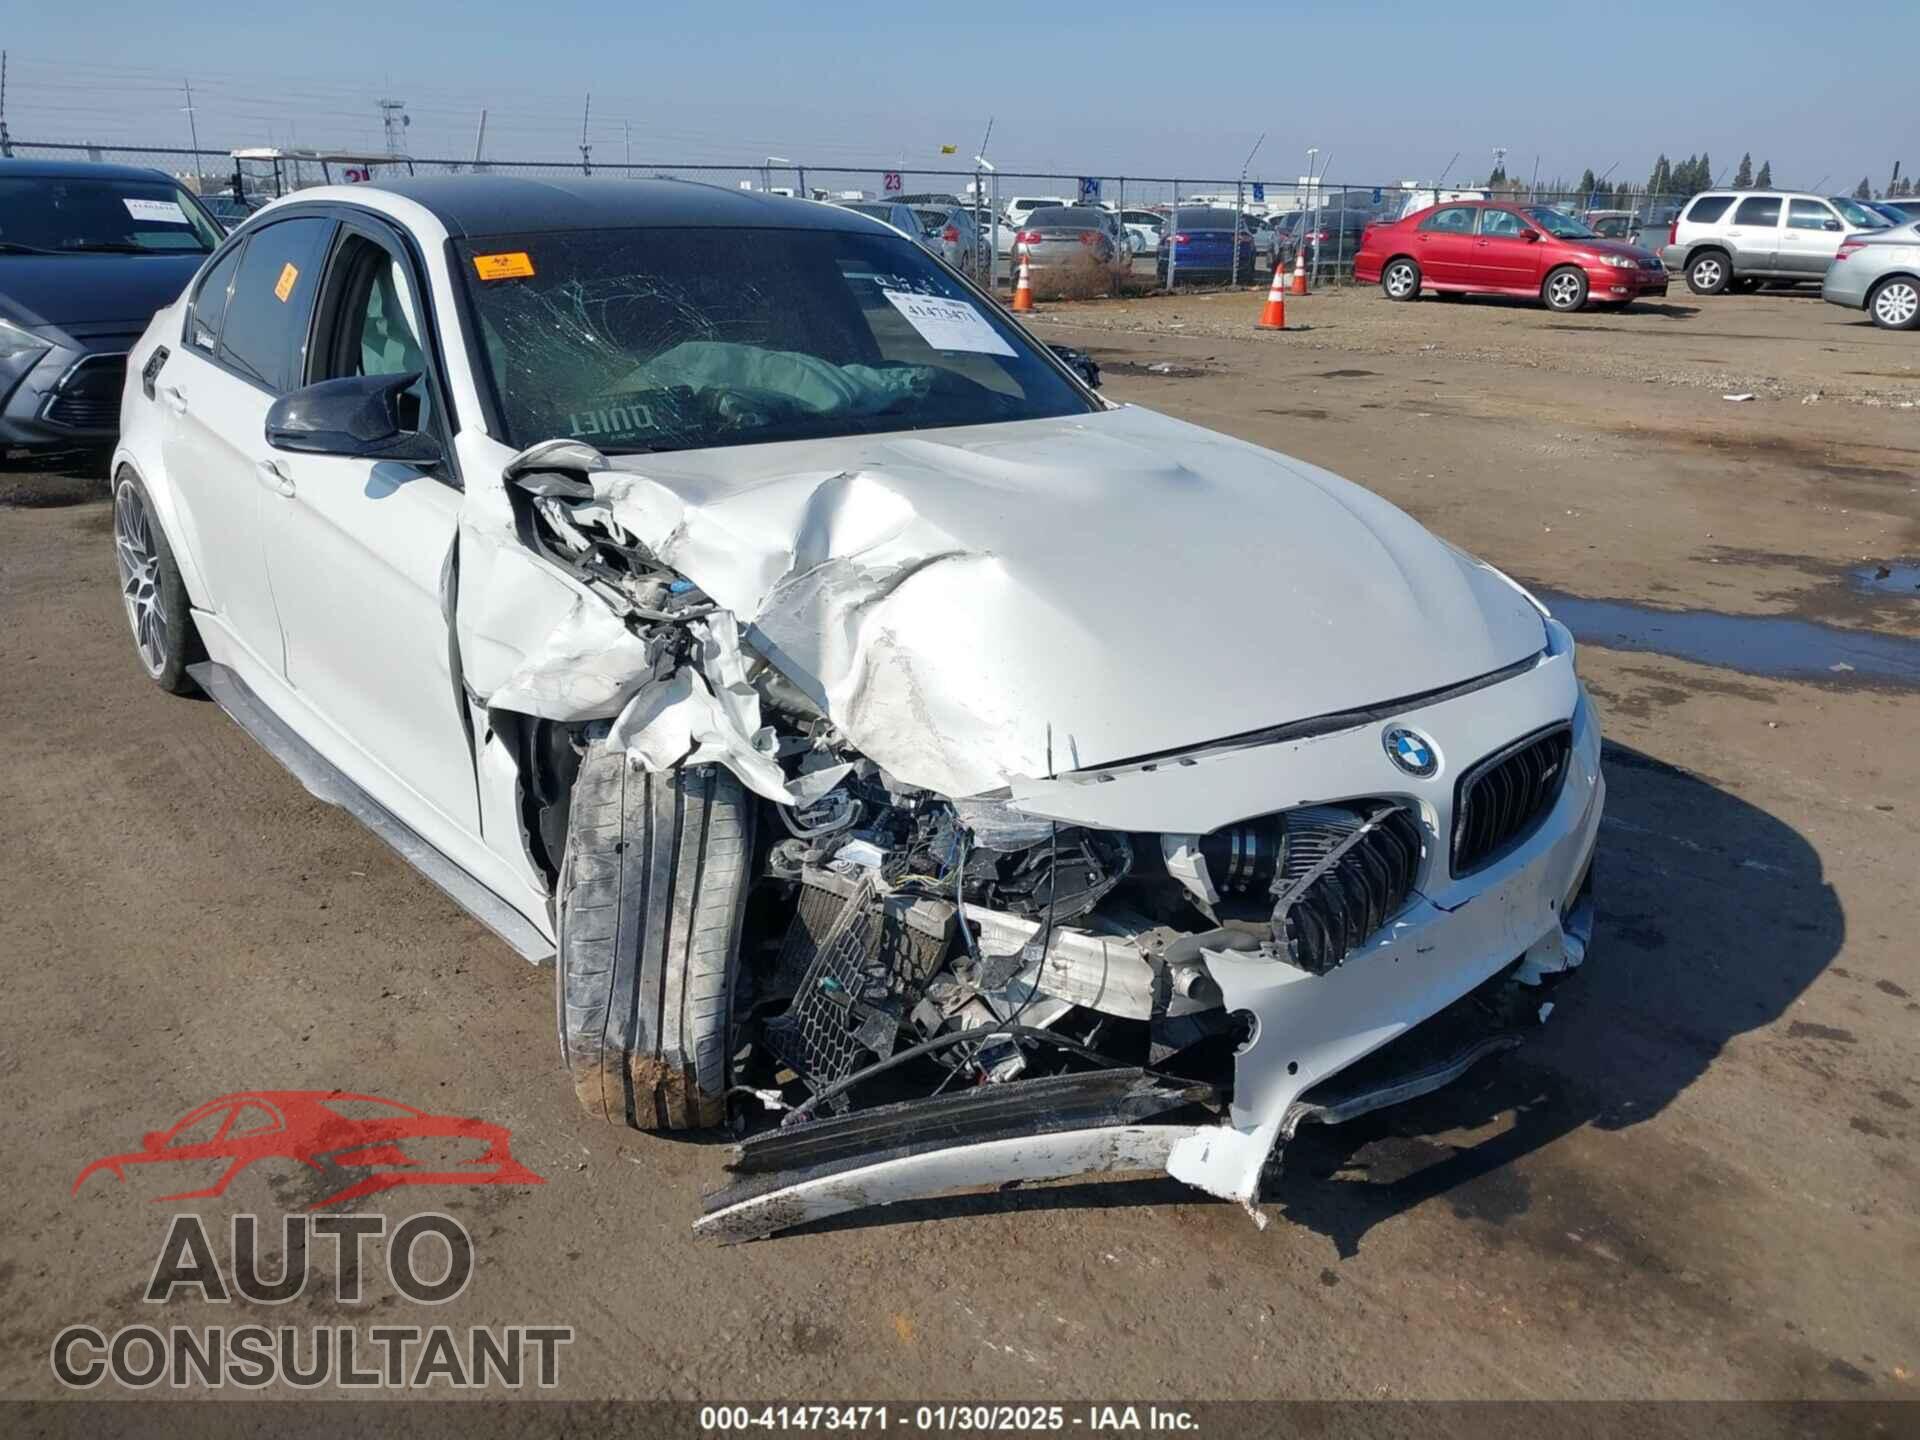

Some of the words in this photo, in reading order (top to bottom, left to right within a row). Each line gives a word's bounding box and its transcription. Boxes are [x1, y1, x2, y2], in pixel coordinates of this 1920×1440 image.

[884, 174, 901, 190] 23
[907, 304, 976, 322] 41473471
[569, 404, 655, 437] QUIET
